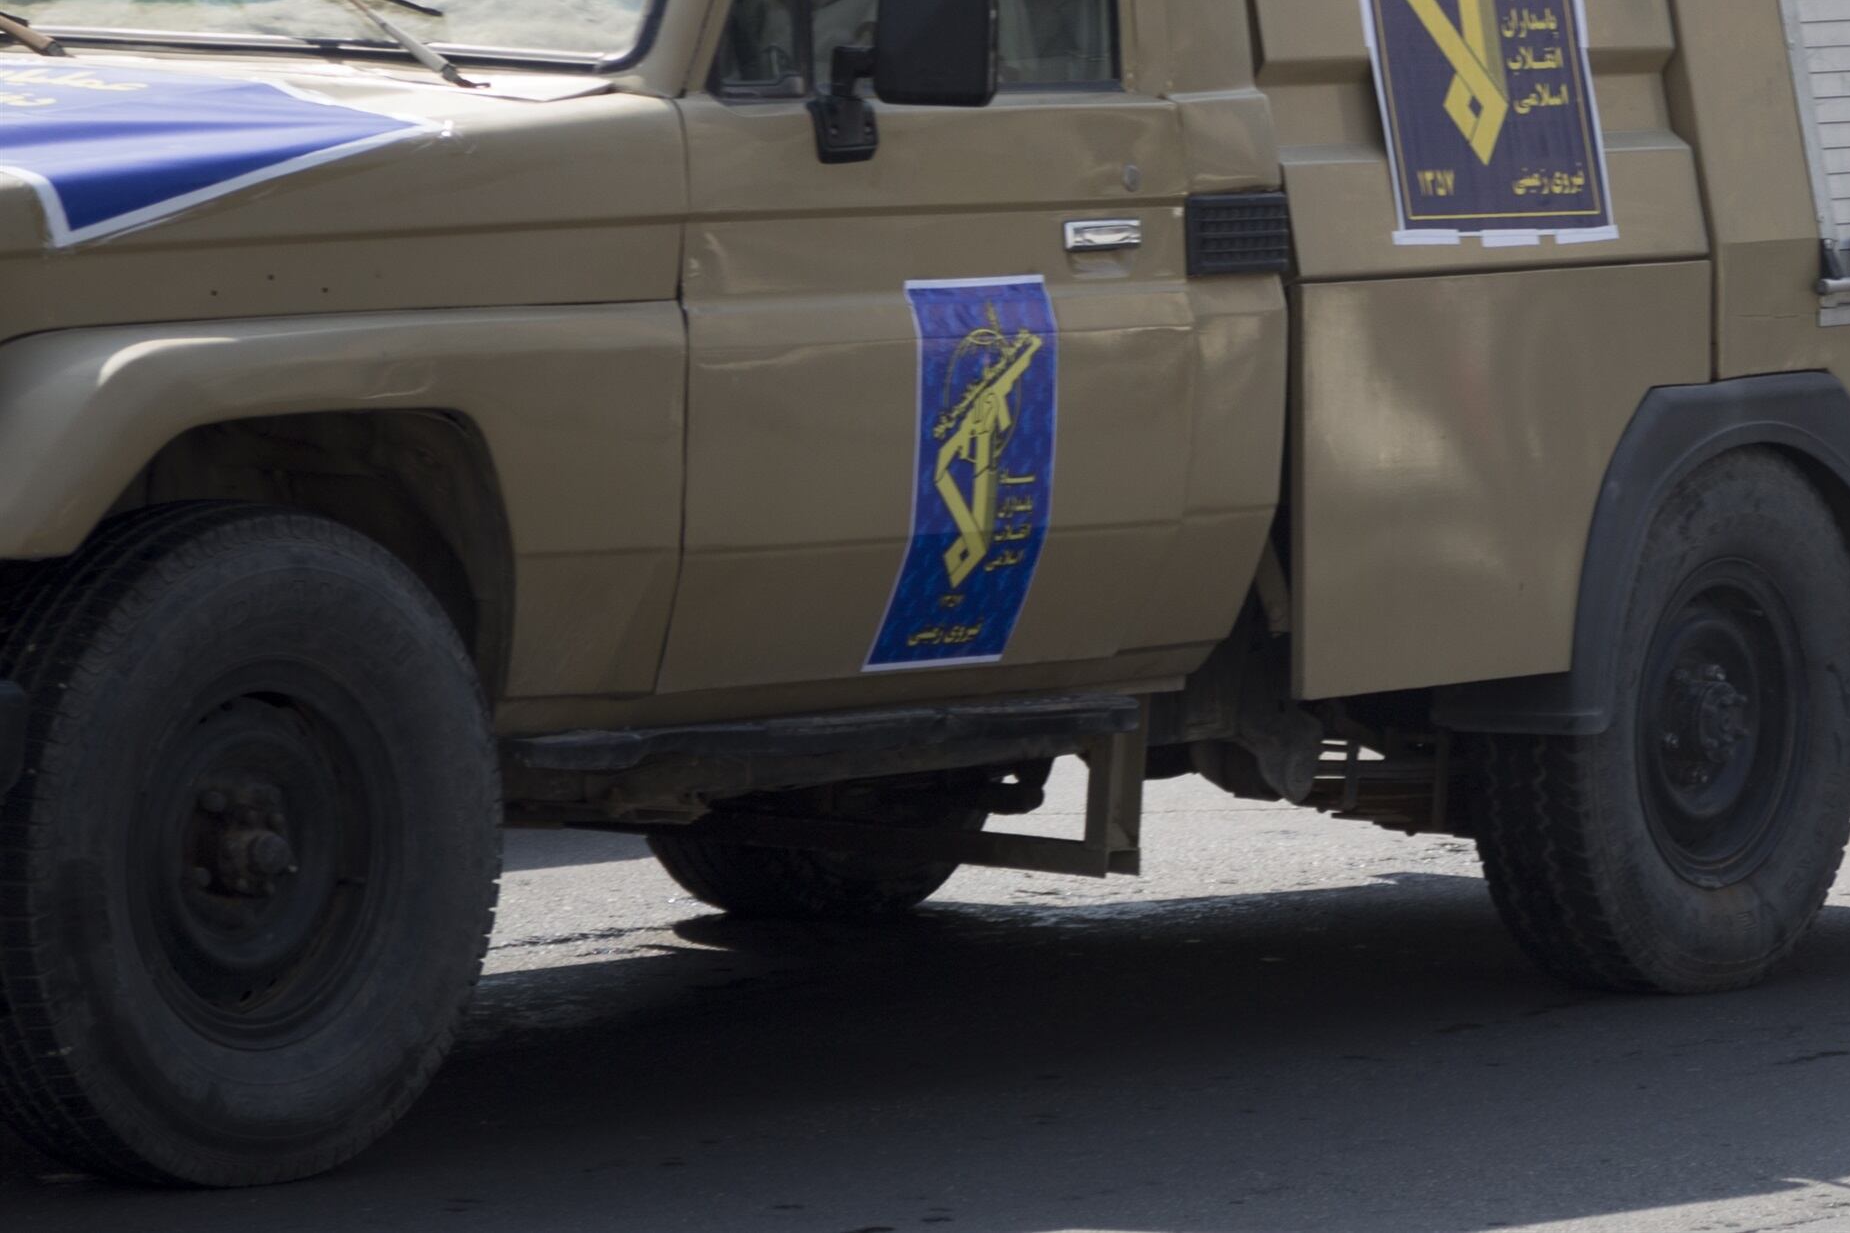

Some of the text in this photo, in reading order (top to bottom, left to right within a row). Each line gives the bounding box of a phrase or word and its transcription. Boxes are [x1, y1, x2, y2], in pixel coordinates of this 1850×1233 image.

[1501, 7, 1559, 38] پاسداران
[1507, 46, 1564, 75] انقلاب
[1513, 83, 1569, 114] اسلامی
[1512, 161, 1585, 195] نیروی زمینی
